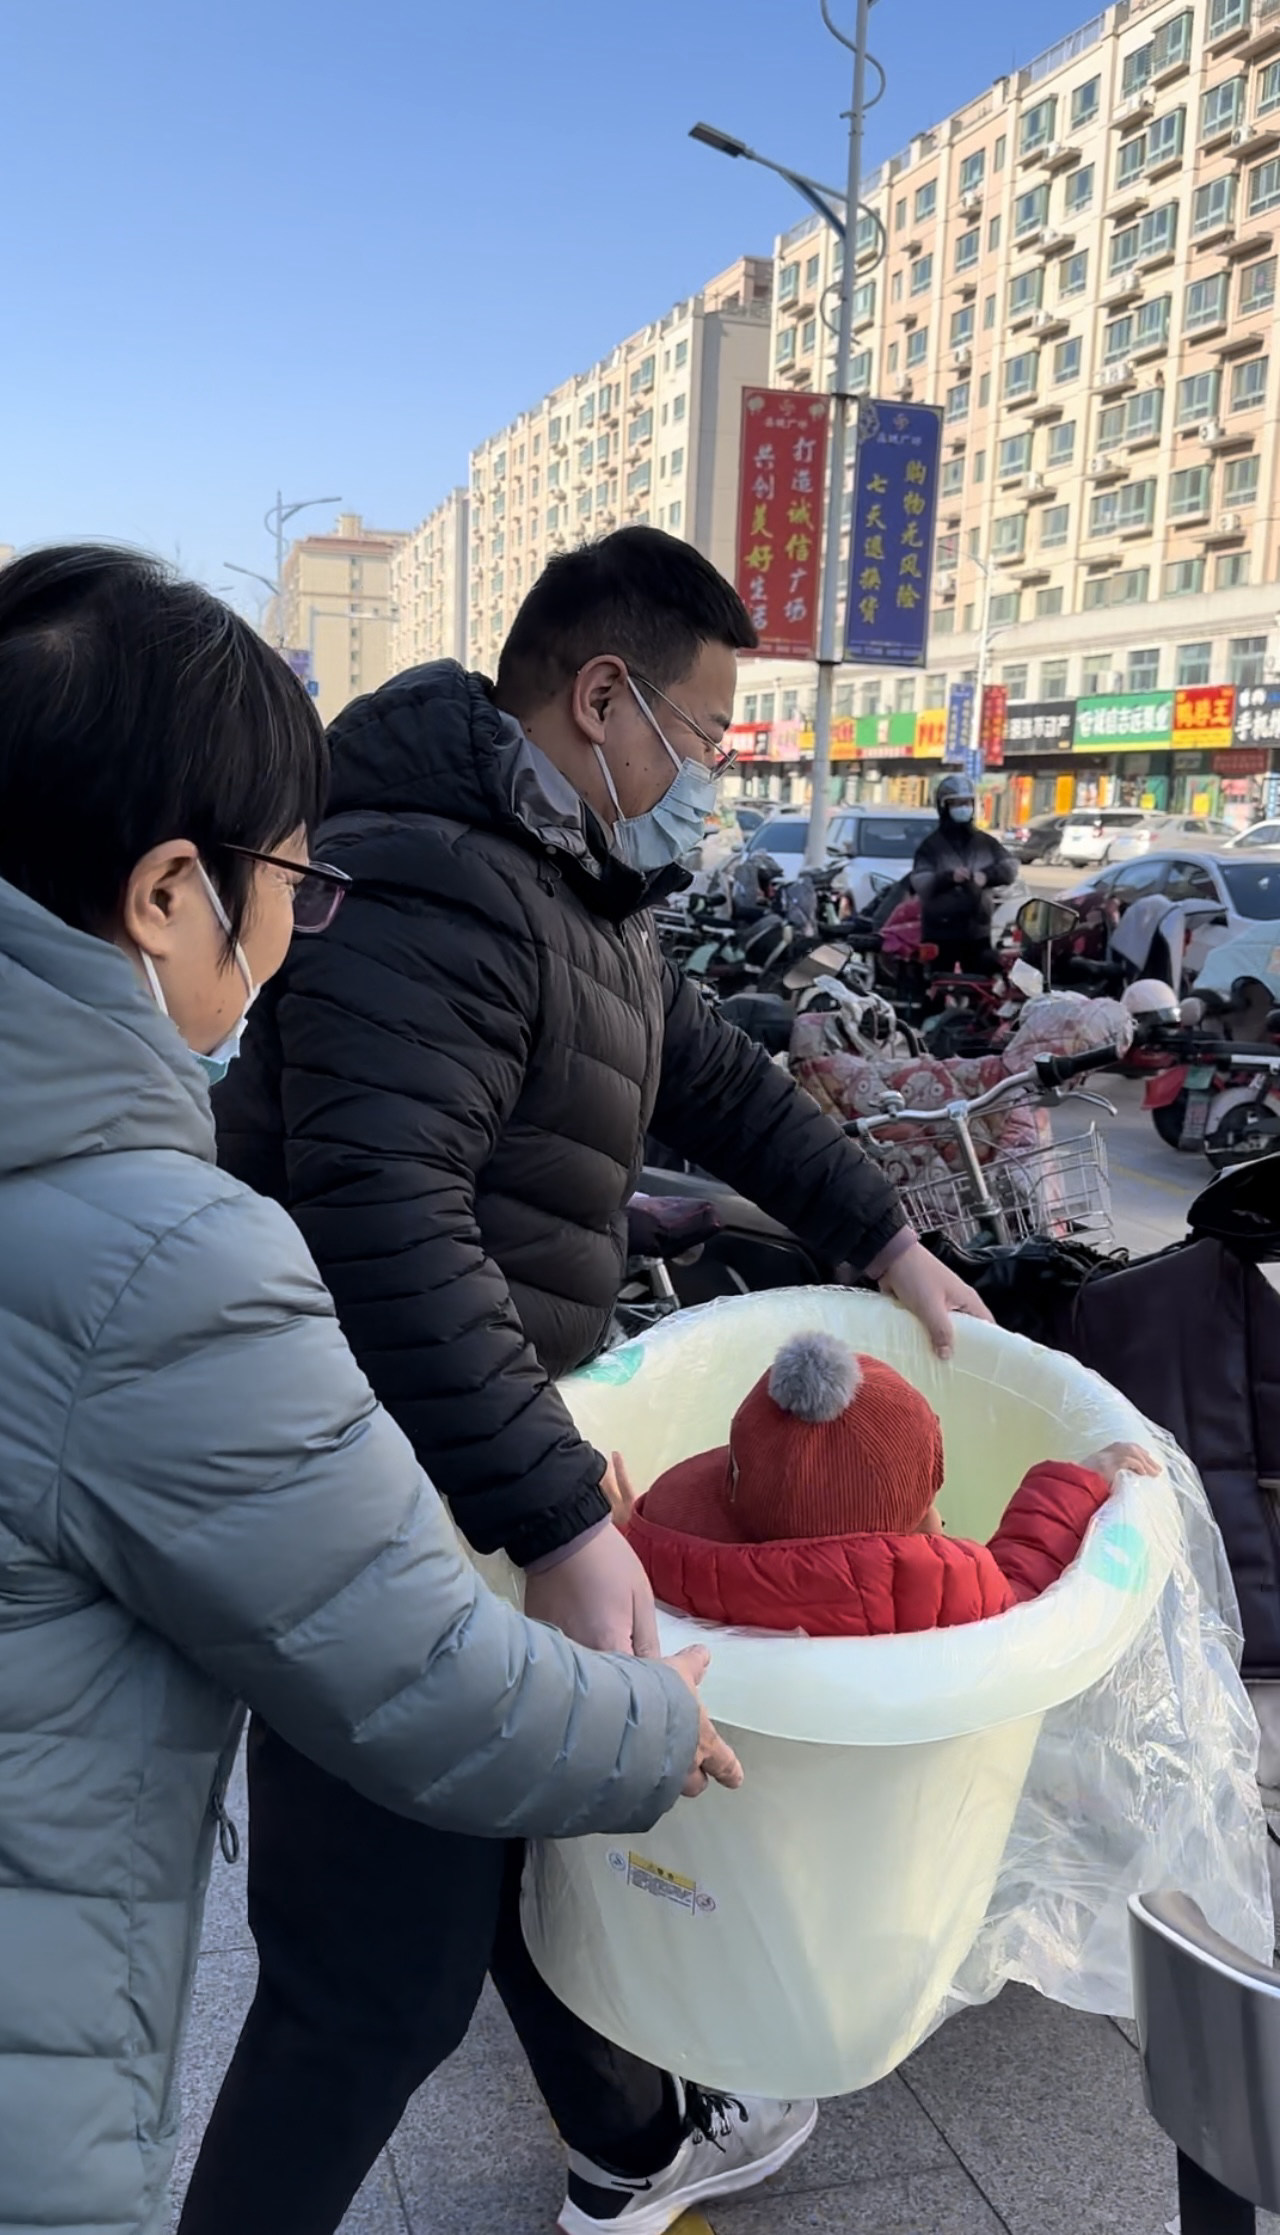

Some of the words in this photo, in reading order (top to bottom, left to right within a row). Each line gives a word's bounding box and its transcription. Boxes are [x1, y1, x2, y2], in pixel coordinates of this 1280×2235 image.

[743, 442, 776, 631] 共创美好生活
[784, 436, 816, 623] 打造诚信广场
[858, 473, 888, 625] 七天退换货
[896, 459, 927, 609] 购物无风险
